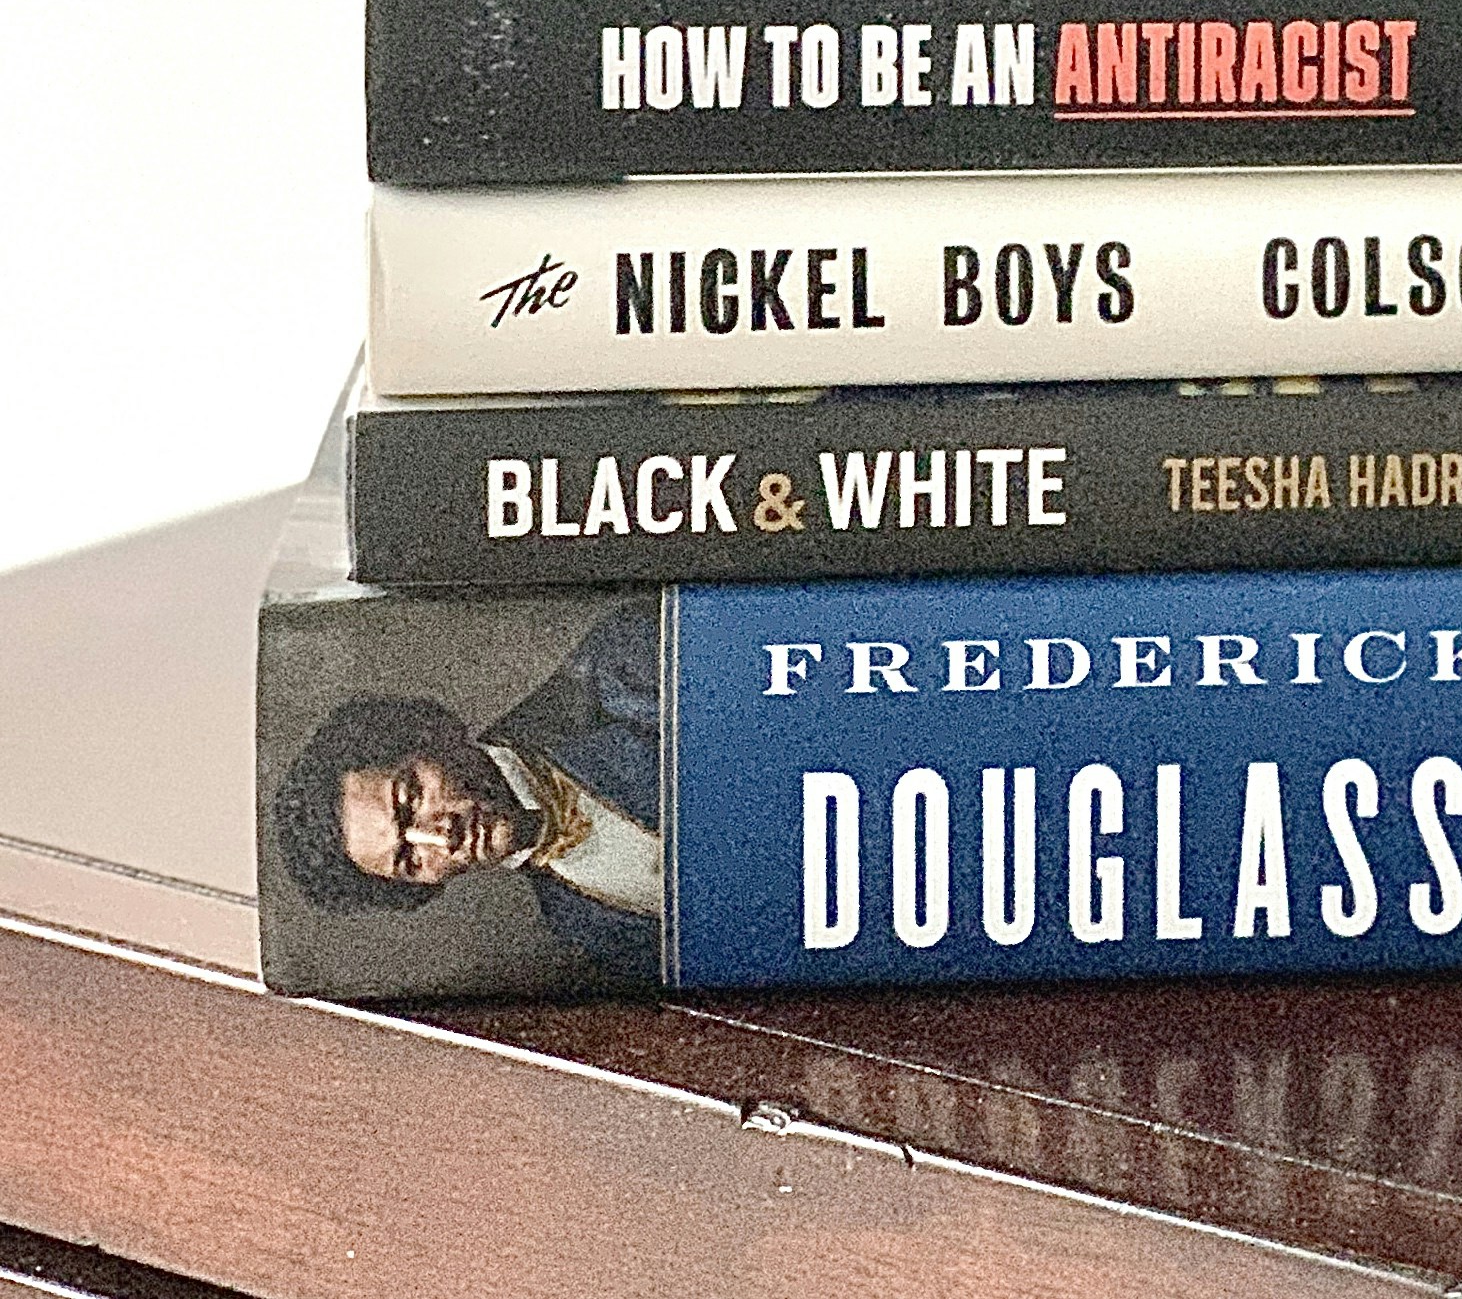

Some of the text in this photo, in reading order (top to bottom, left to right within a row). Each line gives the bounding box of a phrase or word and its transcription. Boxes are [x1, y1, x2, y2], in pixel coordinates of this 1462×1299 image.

[601, 19, 1417, 110] HOW TO BE AN ANTIRACIST
[480, 241, 1135, 335] The NICKEL BOYS
[487, 448, 1067, 538] BLACK & WHITE
[1162, 455, 1331, 512] TEESHA
